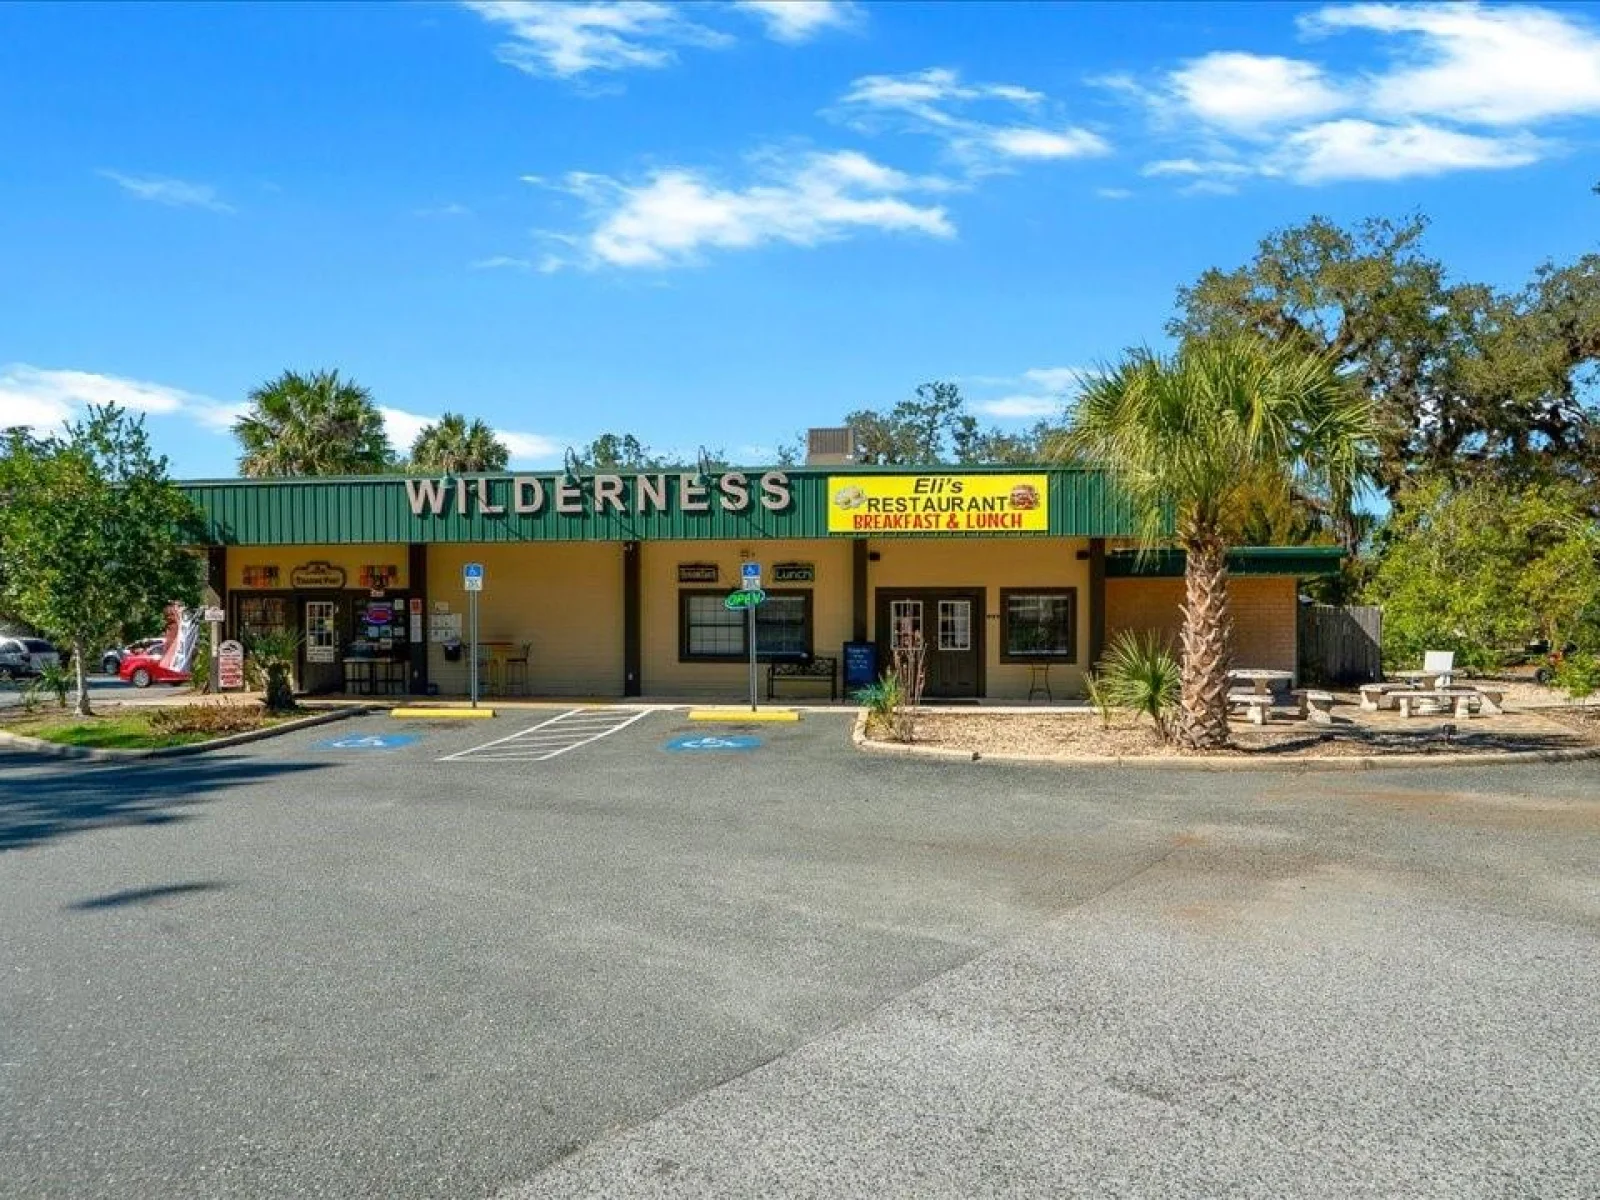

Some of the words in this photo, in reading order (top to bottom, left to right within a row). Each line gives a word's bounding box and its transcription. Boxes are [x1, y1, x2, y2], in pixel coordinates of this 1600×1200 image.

[405, 471, 791, 514] WILDERNESS
[914, 477, 964, 494] Eli's
[867, 496, 1008, 513] RESTAURANT
[852, 513, 941, 530] BREAKFAST
[946, 513, 959, 529] &
[965, 512, 1023, 529] LUNCH
[728, 591, 761, 606] OPEN
